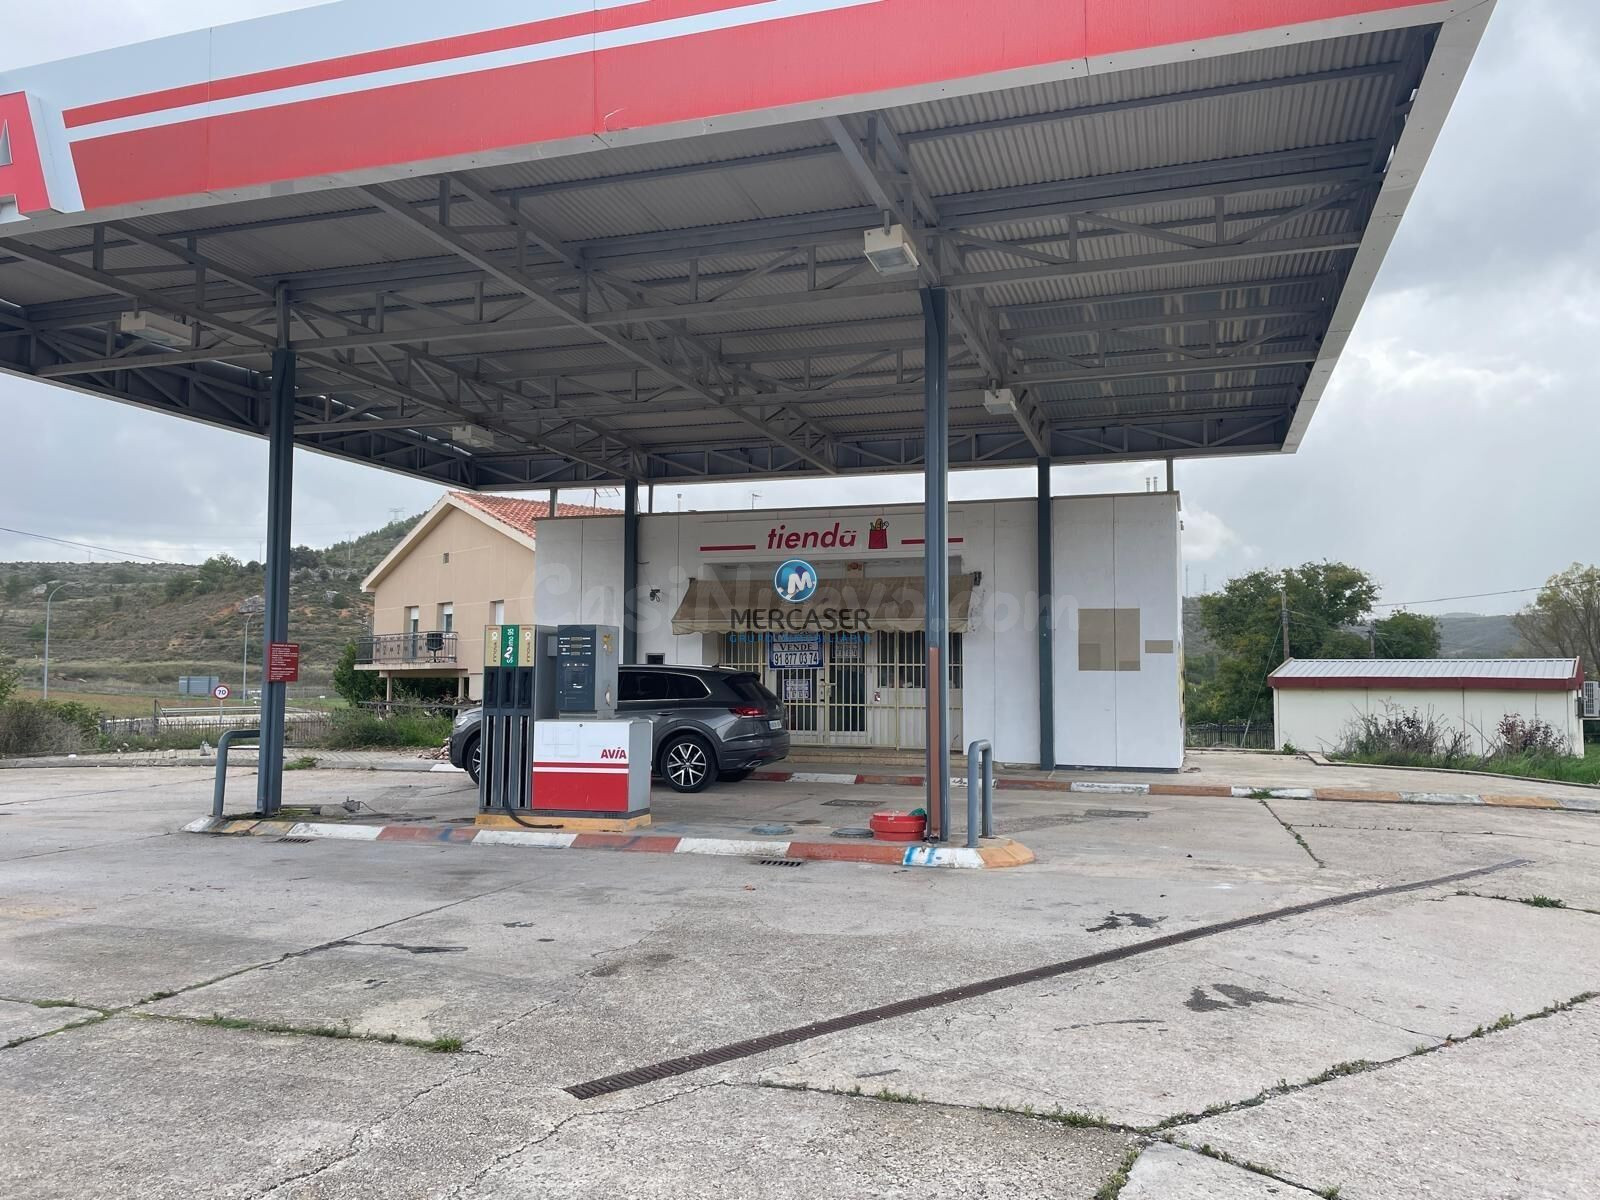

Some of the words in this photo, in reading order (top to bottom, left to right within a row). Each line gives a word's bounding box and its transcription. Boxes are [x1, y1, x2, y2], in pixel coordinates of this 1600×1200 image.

[767, 522, 857, 550] tienda
[780, 643, 813, 651] VENDE
[774, 653, 783, 665] 91
[784, 653, 797, 665] 877
[799, 652, 808, 664] 03
[809, 652, 818, 664] 74
